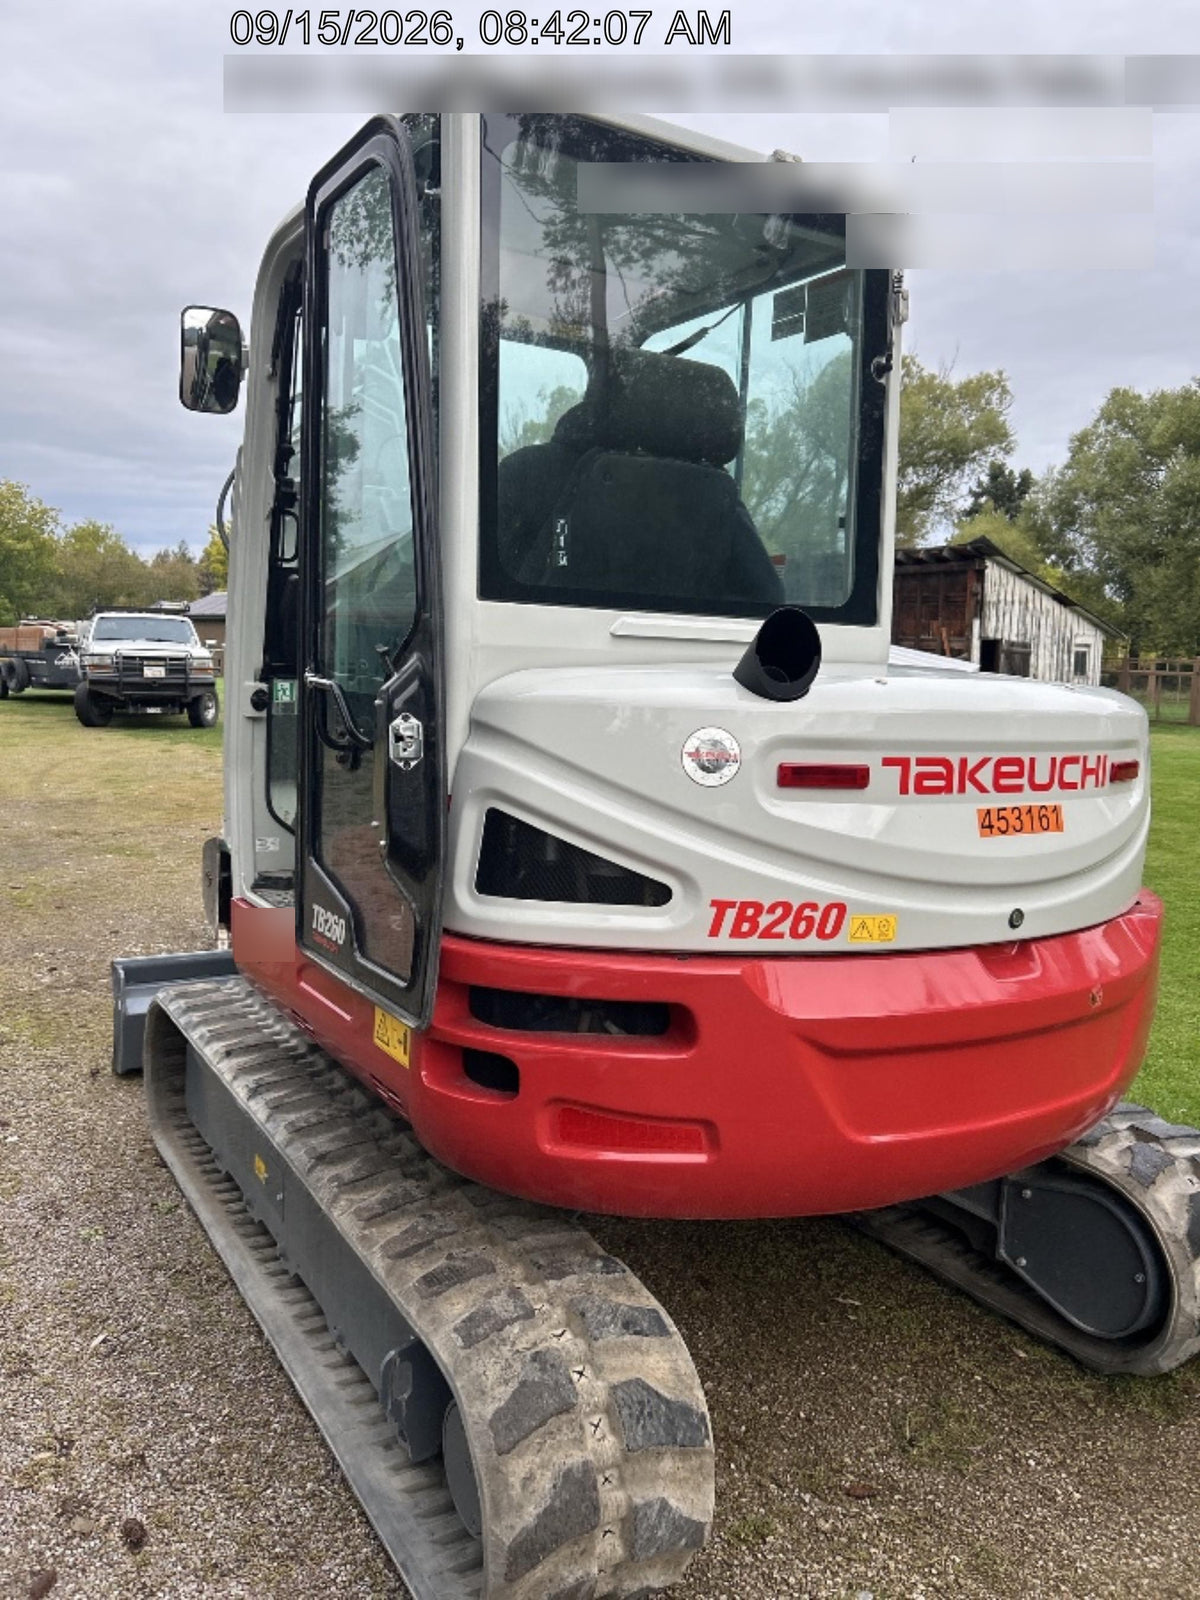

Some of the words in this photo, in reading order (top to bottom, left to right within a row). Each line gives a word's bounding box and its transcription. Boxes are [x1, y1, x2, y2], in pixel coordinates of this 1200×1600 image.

[980, 804, 1060, 835] 453161
[311, 902, 346, 945] TB260
[707, 899, 847, 940] TB260
